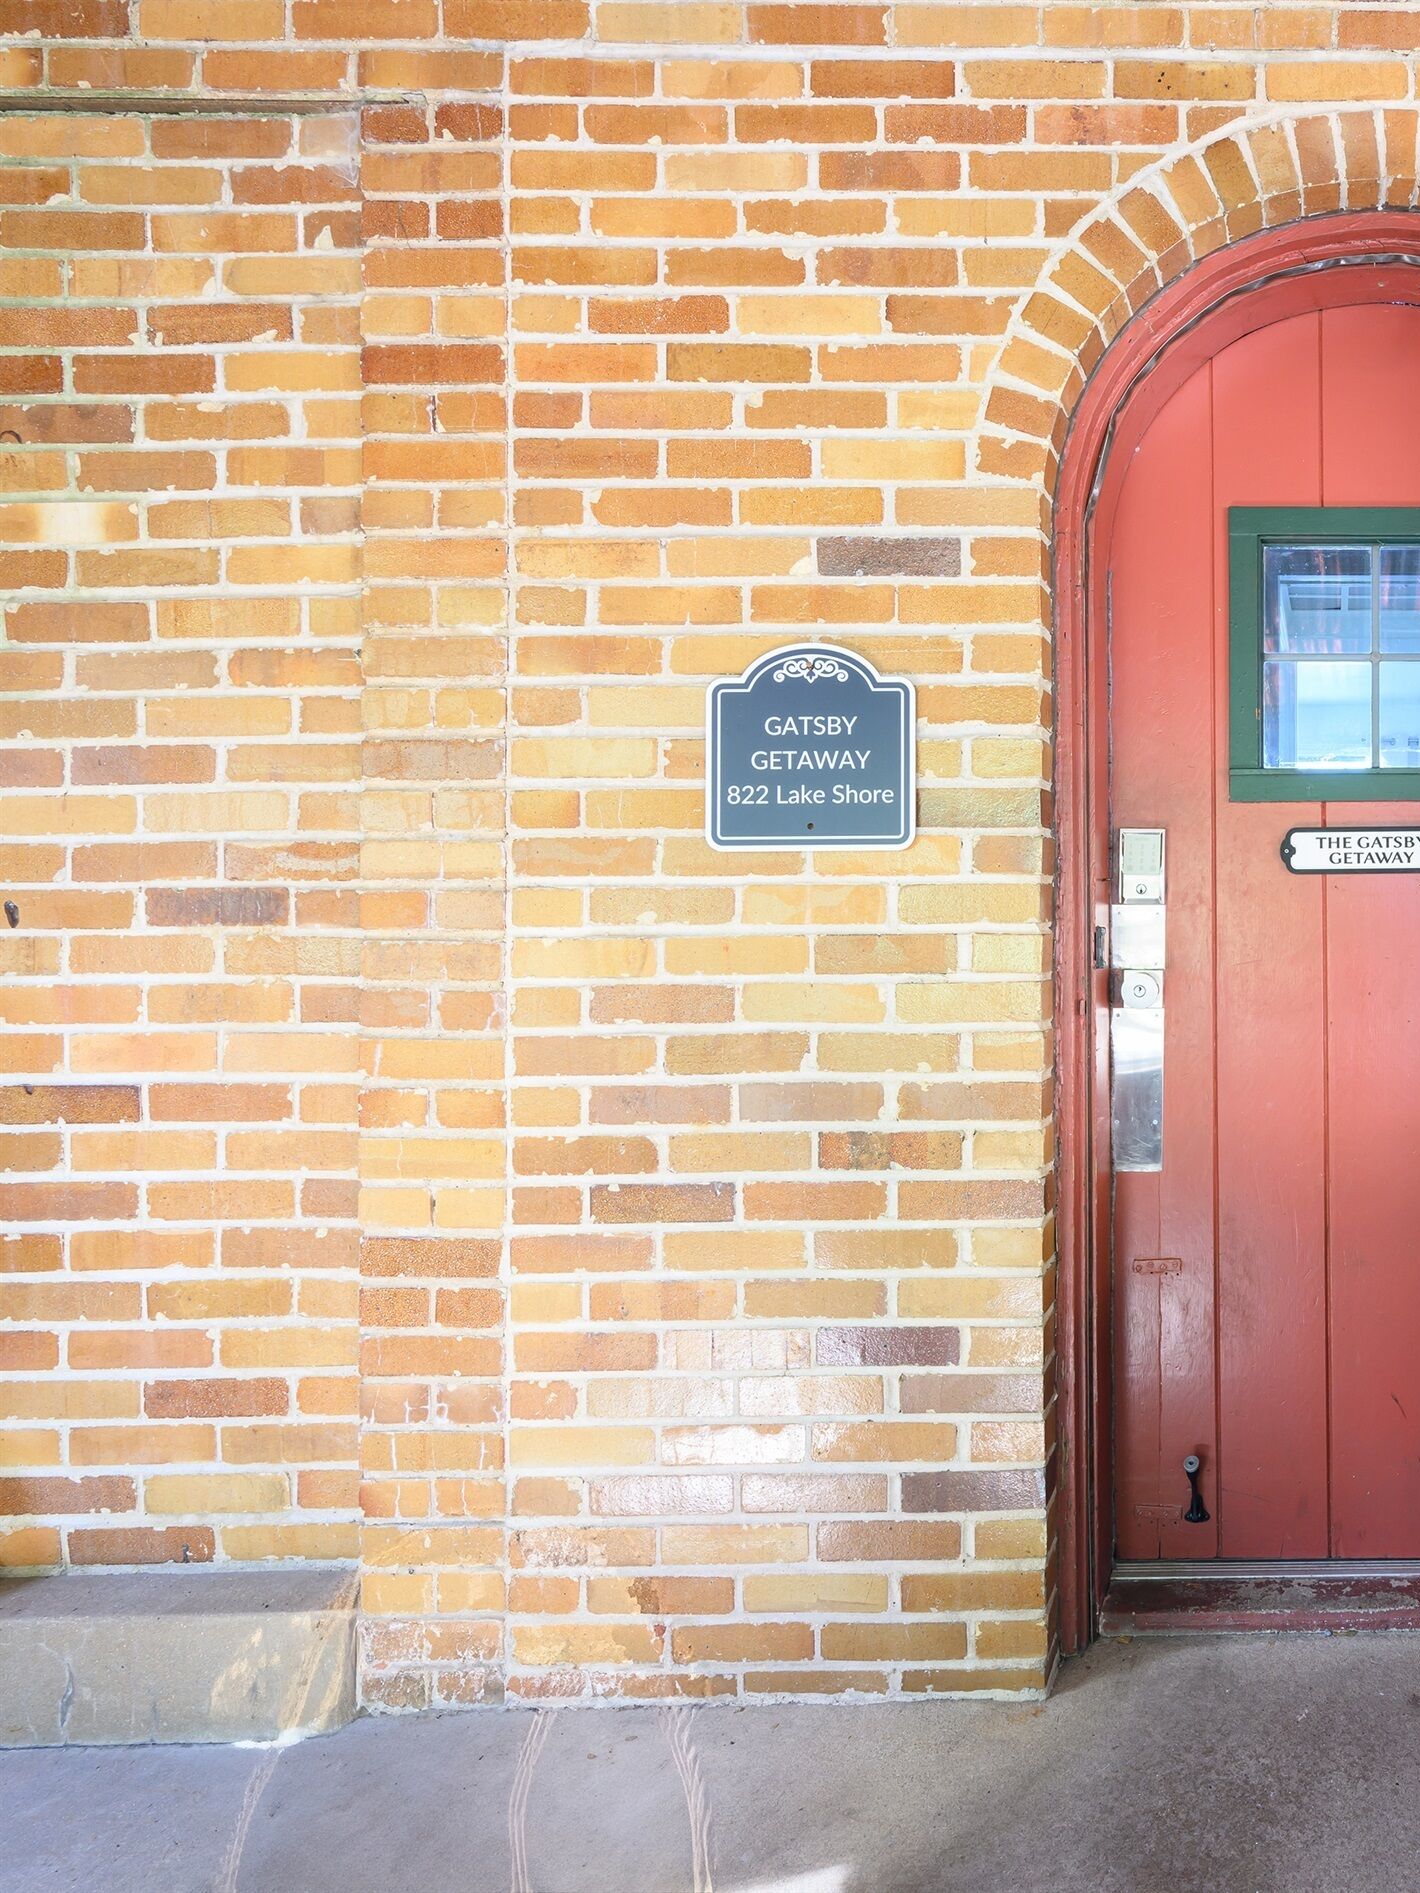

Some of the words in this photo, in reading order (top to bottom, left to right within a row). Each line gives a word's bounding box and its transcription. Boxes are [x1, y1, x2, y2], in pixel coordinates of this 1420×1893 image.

[764, 715, 858, 736] GATSBY
[751, 750, 871, 771] GETAWAY
[726, 785, 769, 805] 822
[776, 785, 825, 804] Lake
[832, 784, 894, 804] Shore
[1315, 837, 1352, 849] THE
[1329, 851, 1414, 865] GETAWAY
